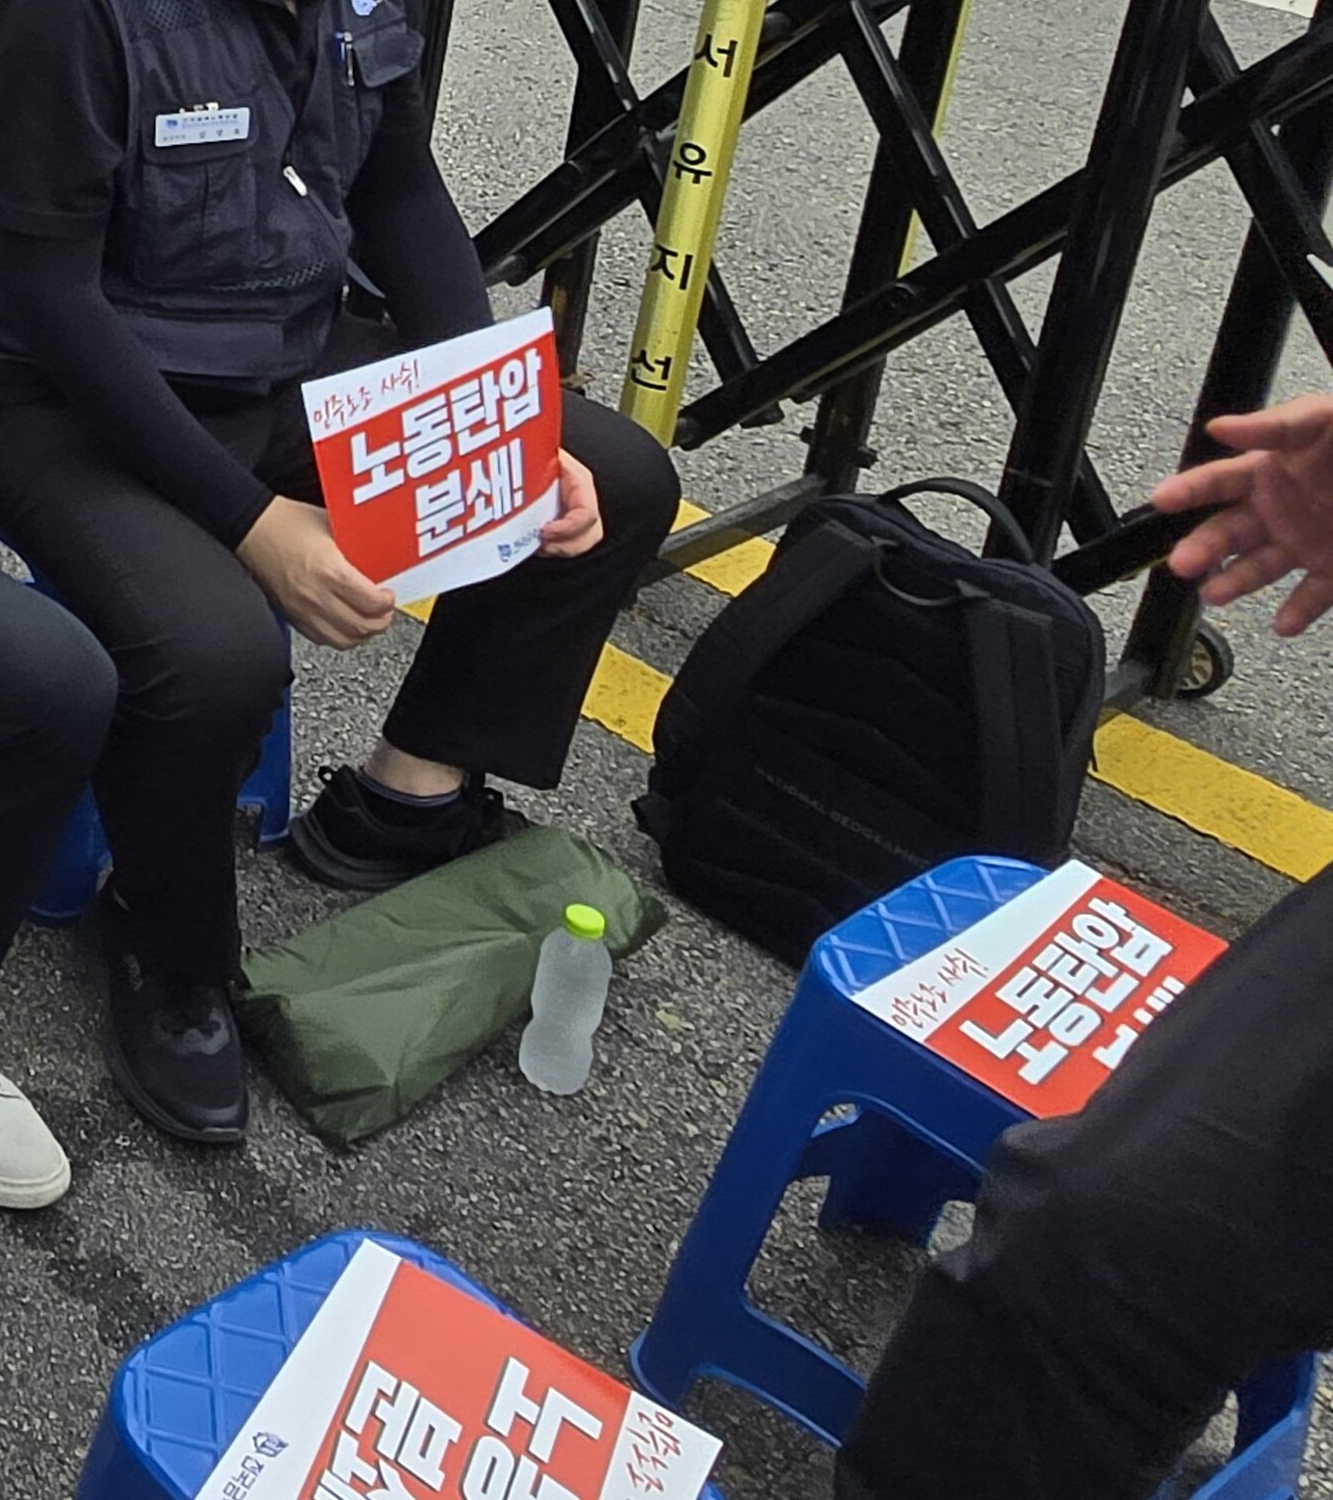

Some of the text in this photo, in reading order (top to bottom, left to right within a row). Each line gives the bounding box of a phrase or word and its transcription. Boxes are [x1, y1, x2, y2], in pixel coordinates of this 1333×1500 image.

[349, 347, 543, 506] 노동탄압
[414, 437, 525, 558] 분쇄!
[958, 895, 1174, 1086] 노동탄압
